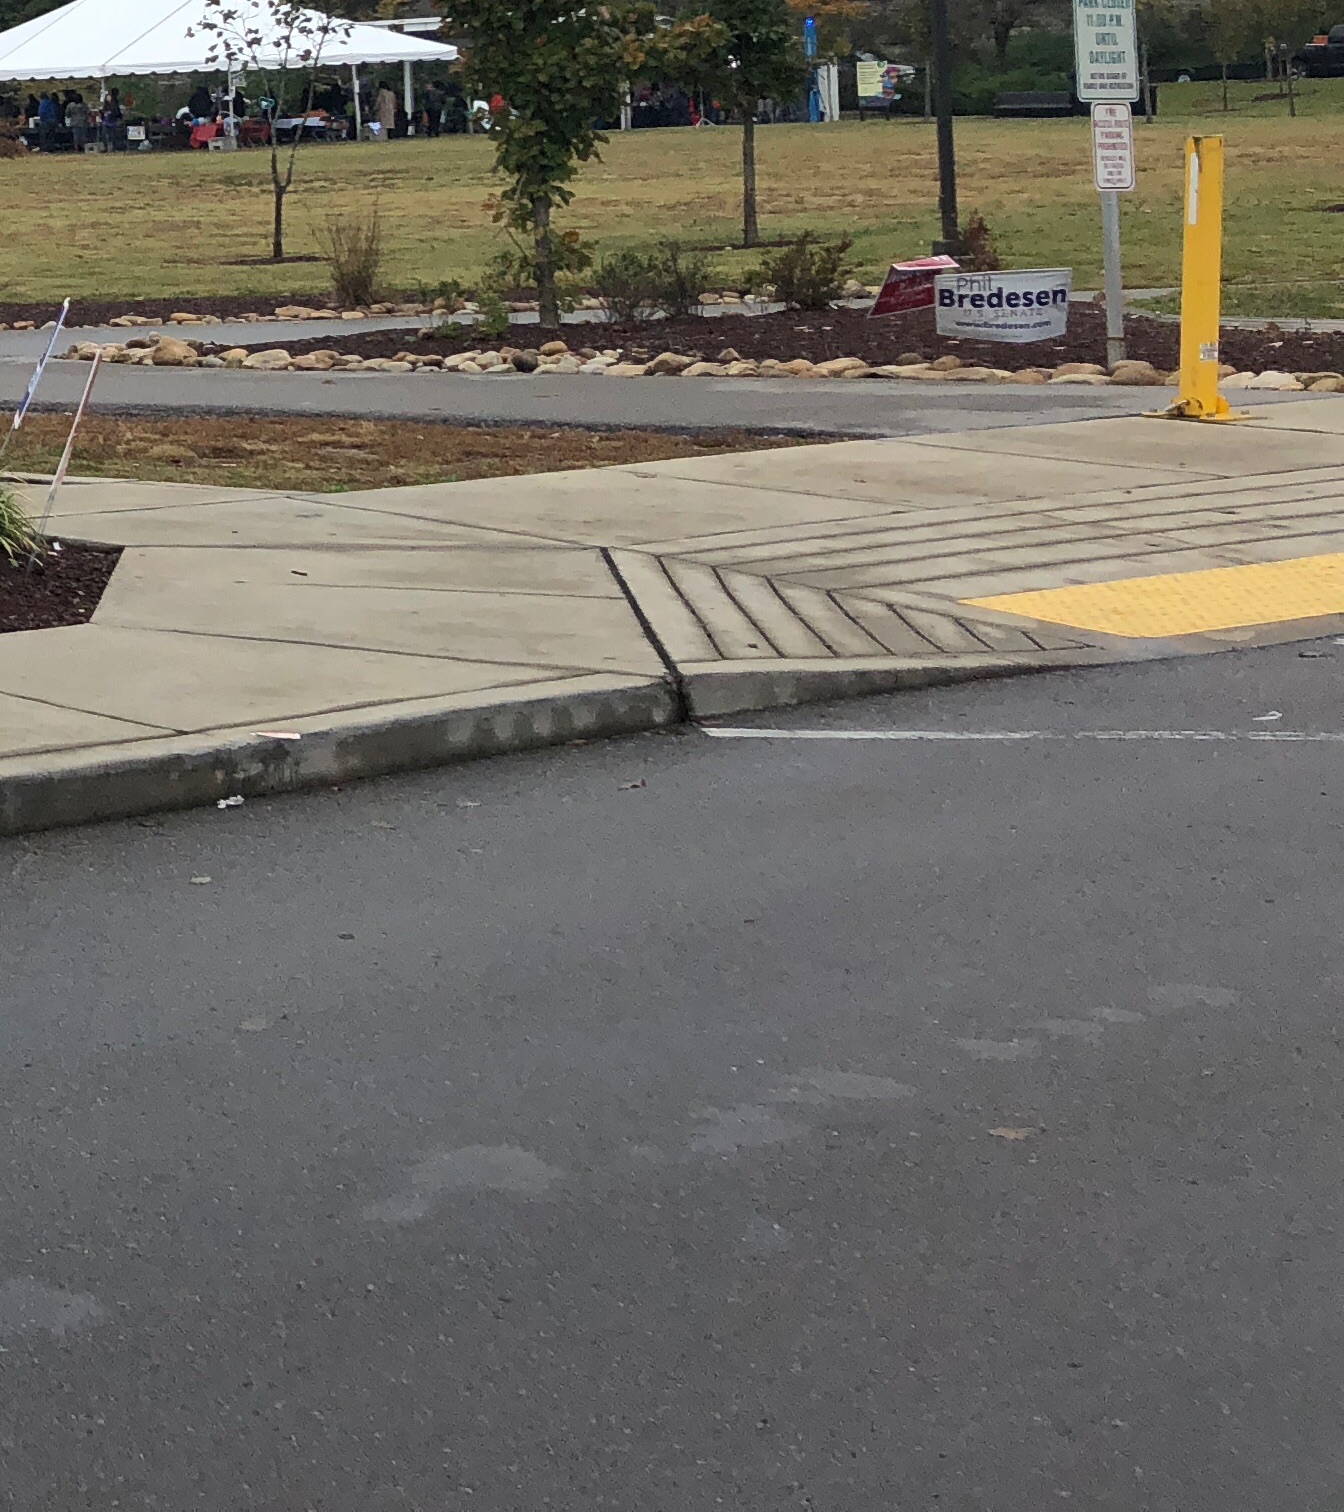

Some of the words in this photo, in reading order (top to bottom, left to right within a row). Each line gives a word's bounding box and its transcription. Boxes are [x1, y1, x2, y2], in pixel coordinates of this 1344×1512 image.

[1089, 50, 1126, 64] DAYLIGHT
[956, 275, 992, 293] Phil
[938, 287, 1067, 309] Bredesen
